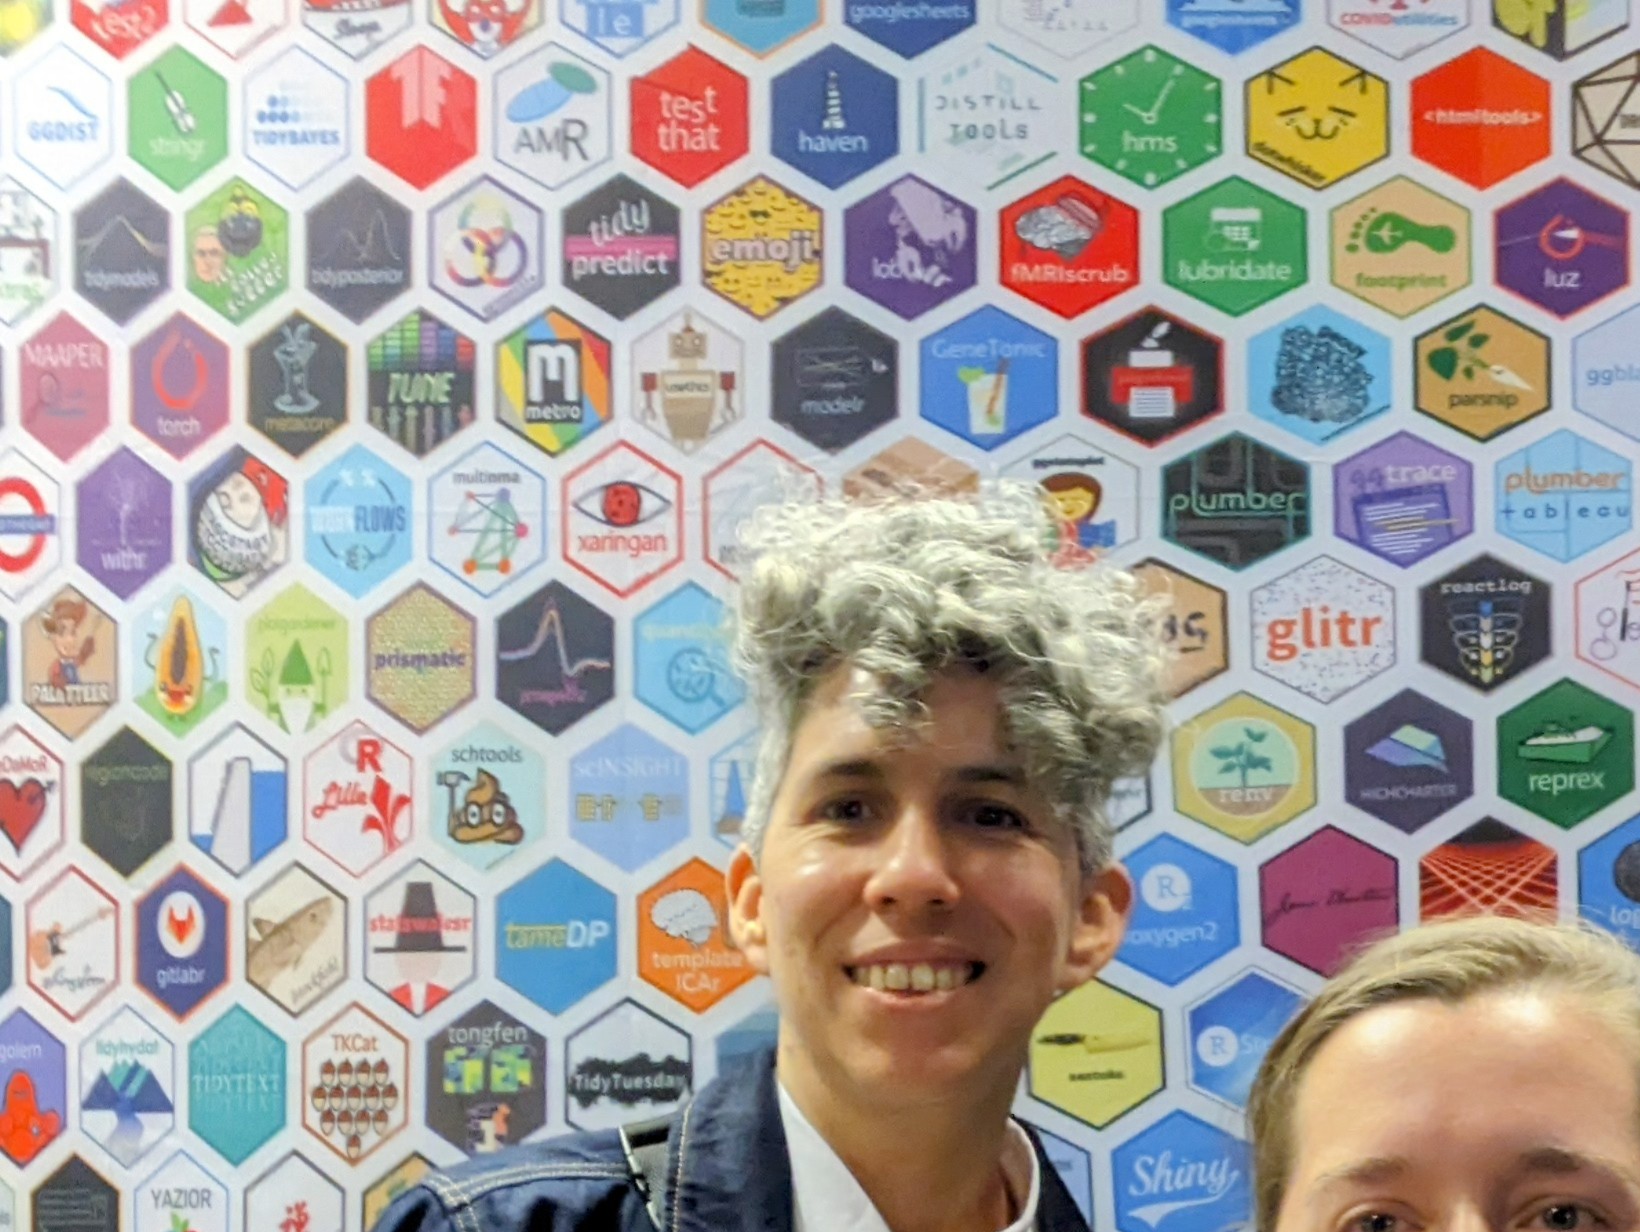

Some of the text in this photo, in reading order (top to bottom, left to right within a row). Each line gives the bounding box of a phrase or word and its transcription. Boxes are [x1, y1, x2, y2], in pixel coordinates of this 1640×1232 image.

[658, 86, 717, 122] test
[28, 121, 98, 142] GGDIST
[252, 129, 340, 146] TIDYBAYES
[513, 118, 589, 161] AMR
[657, 123, 721, 153] that
[798, 130, 868, 154] haven
[950, 124, 1028, 141] TOOLS
[1121, 131, 1178, 154] hms
[590, 200, 650, 247] tidy
[712, 229, 816, 271] emoji
[572, 252, 668, 281] predict
[1178, 261, 1292, 282] lubridate
[1543, 268, 1581, 290] luz
[931, 340, 1046, 361] GeneTonic
[525, 402, 582, 422] metro
[157, 416, 201, 437] torch
[1504, 465, 1628, 495] plumber
[1168, 492, 1310, 515] plumber
[577, 530, 668, 558] xaringan
[1439, 576, 1533, 596] reactlog
[1266, 605, 1383, 664] glitr
[374, 652, 466, 672] prismatic
[451, 745, 524, 764] schtools
[1529, 771, 1607, 795] reprex
[651, 949, 744, 970] template
[156, 967, 207, 990] gitlabr
[331, 1033, 379, 1053] TKCat
[447, 1022, 528, 1050] tongfen
[191, 1074, 281, 1094] TIDYTEXT
[1128, 1149, 1240, 1200] Shiny
[151, 1188, 212, 1210] YAZIOR
